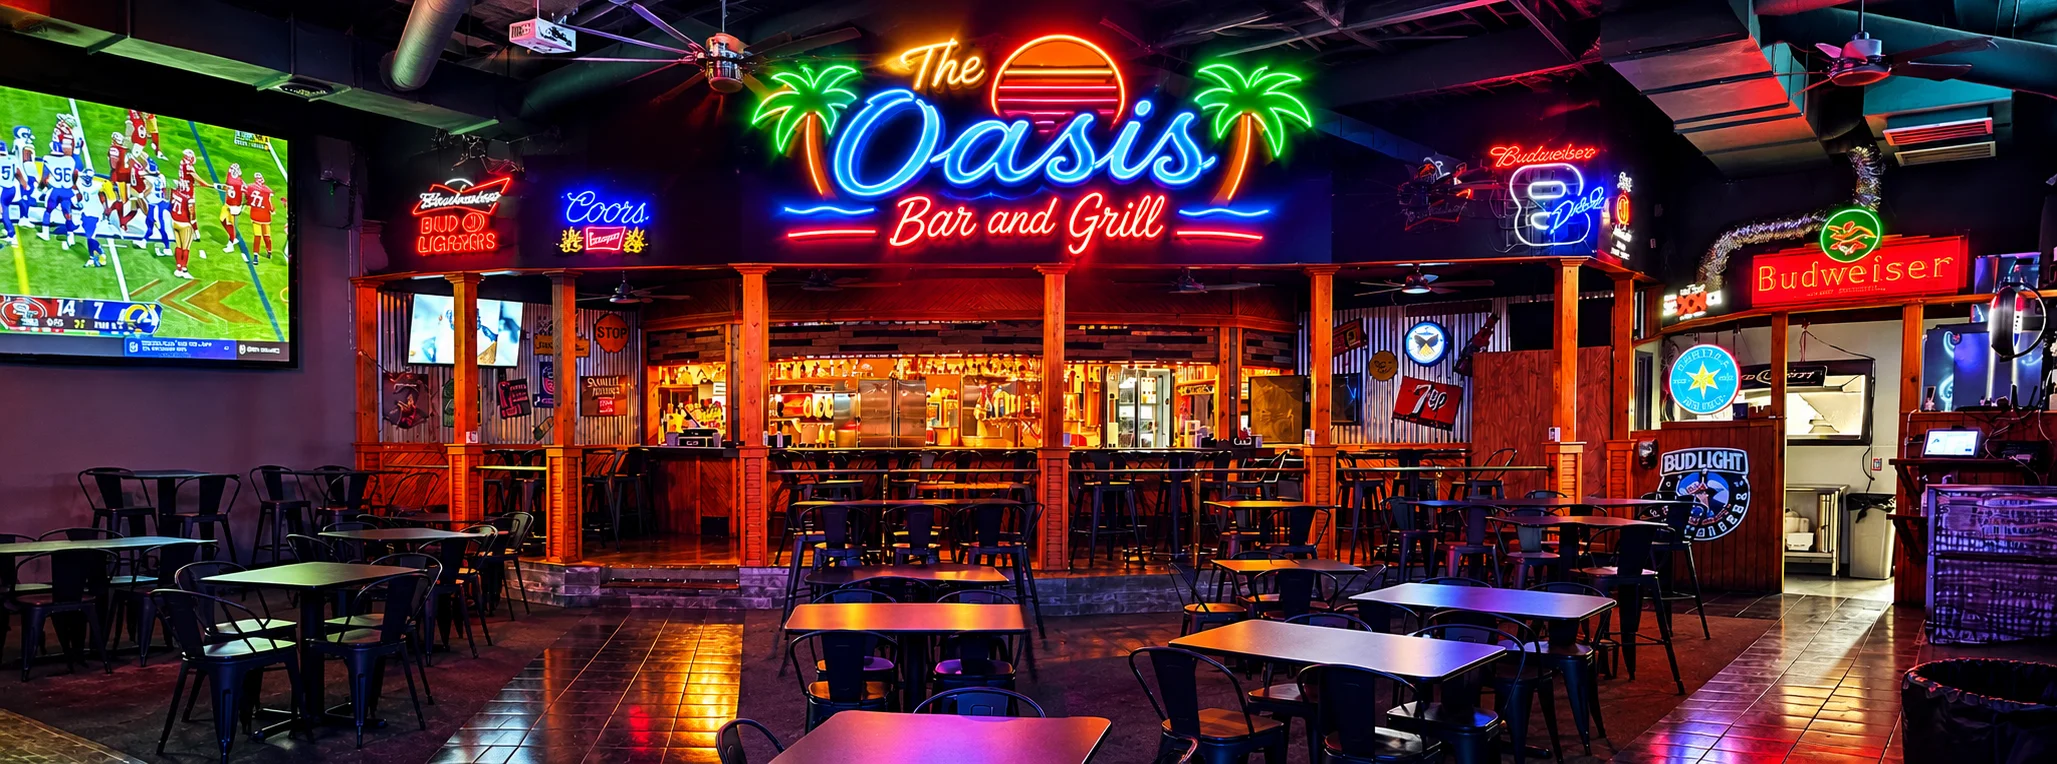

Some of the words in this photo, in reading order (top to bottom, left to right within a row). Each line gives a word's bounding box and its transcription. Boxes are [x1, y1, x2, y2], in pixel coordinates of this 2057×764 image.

[900, 37, 985, 90] The
[834, 88, 1216, 196] Oasis
[889, 196, 977, 247] Bar
[987, 197, 1058, 237] and
[1067, 192, 1166, 255] Grill
[1758, 254, 1954, 292] Budweiser
[56, 299, 76, 317] 14
[93, 301, 104, 320] 7
[597, 326, 628, 339] STOP
[1663, 452, 1697, 473] BUD
[1698, 450, 1743, 471] LIGHT
